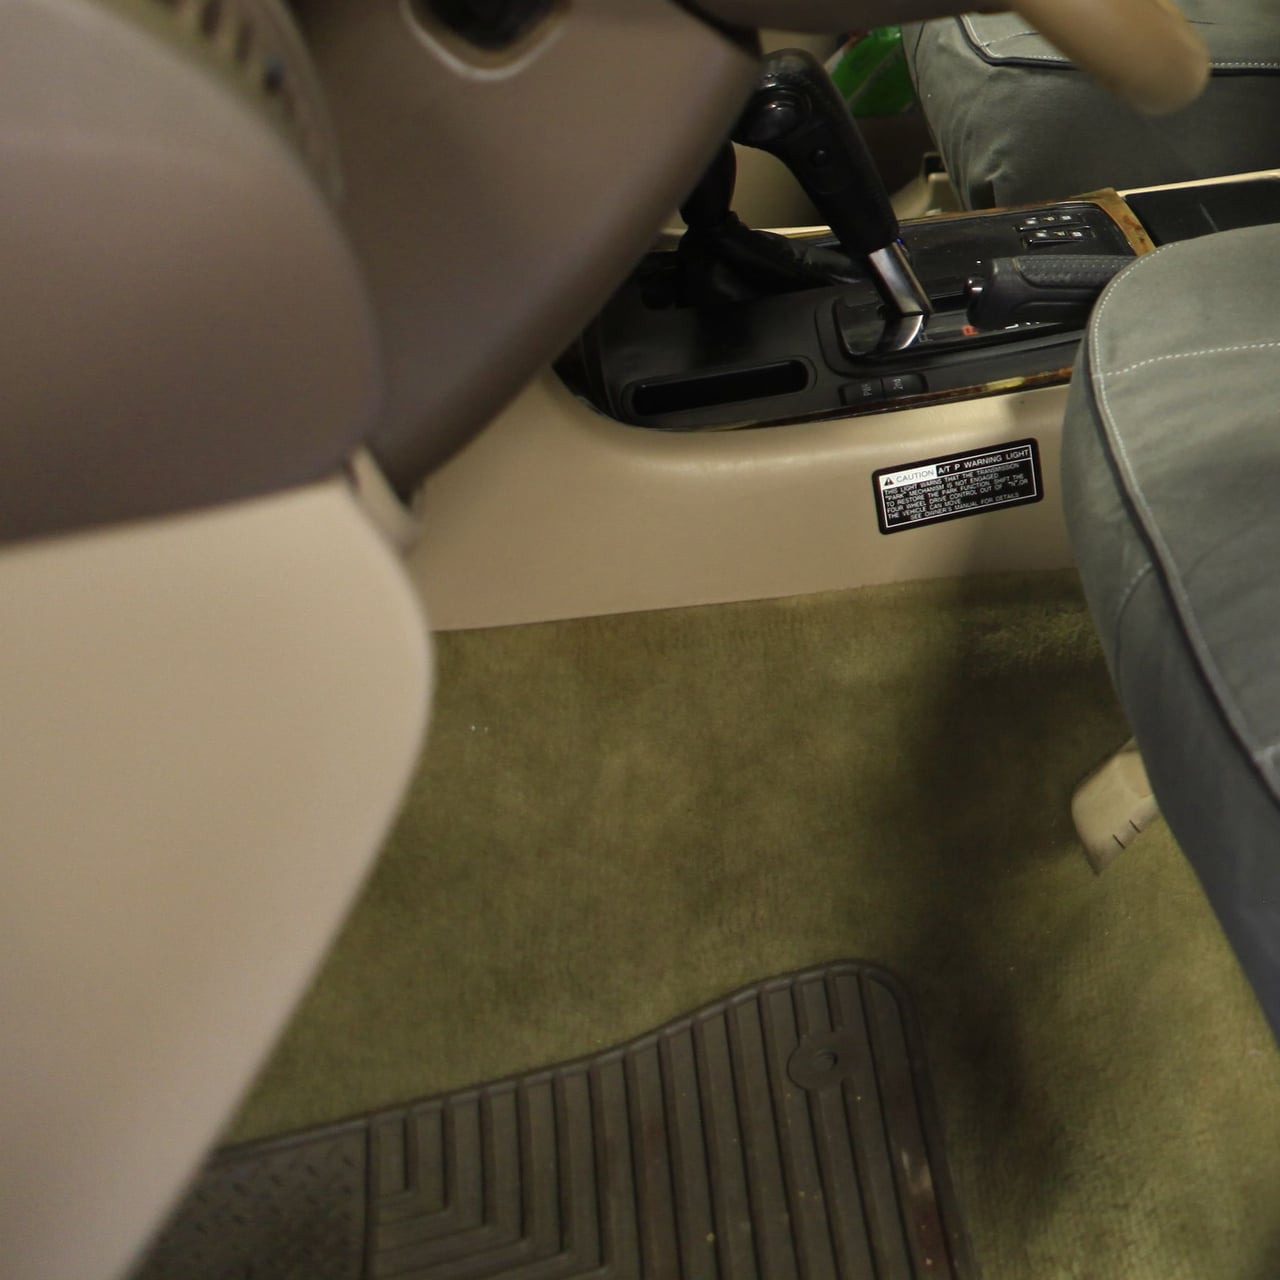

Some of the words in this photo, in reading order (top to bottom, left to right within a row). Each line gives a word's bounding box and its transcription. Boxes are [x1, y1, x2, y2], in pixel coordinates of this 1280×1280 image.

[896, 469, 935, 482] CAUTION
[938, 465, 951, 474] A/T
[954, 463, 961, 471] P
[964, 455, 1002, 468] WARNING
[1006, 449, 1029, 460] LIGHT
[884, 487, 898, 496] THIS
[900, 484, 917, 493] LIGHT
[920, 479, 942, 489] WARNS
[945, 475, 959, 483] THAT
[976, 463, 1020, 476] TRANSMISSION
[897, 495, 925, 505] RESTORE
[942, 488, 958, 496] PARK
[994, 476, 1010, 484] SHIFT
[909, 484, 945, 496] MECHANISM
[955, 479, 967, 487] NOT
[886, 505, 904, 513] FOUR
[906, 500, 927, 509] WHEEL
[929, 496, 947, 504] DRIVE
[949, 490, 977, 500] CONTROL
[980, 486, 992, 494] OUT
[902, 507, 927, 516] VEHICLE
[954, 501, 978, 510] MANUAL
[980, 496, 993, 504] FOR
[995, 492, 1019, 501] DETAILS
